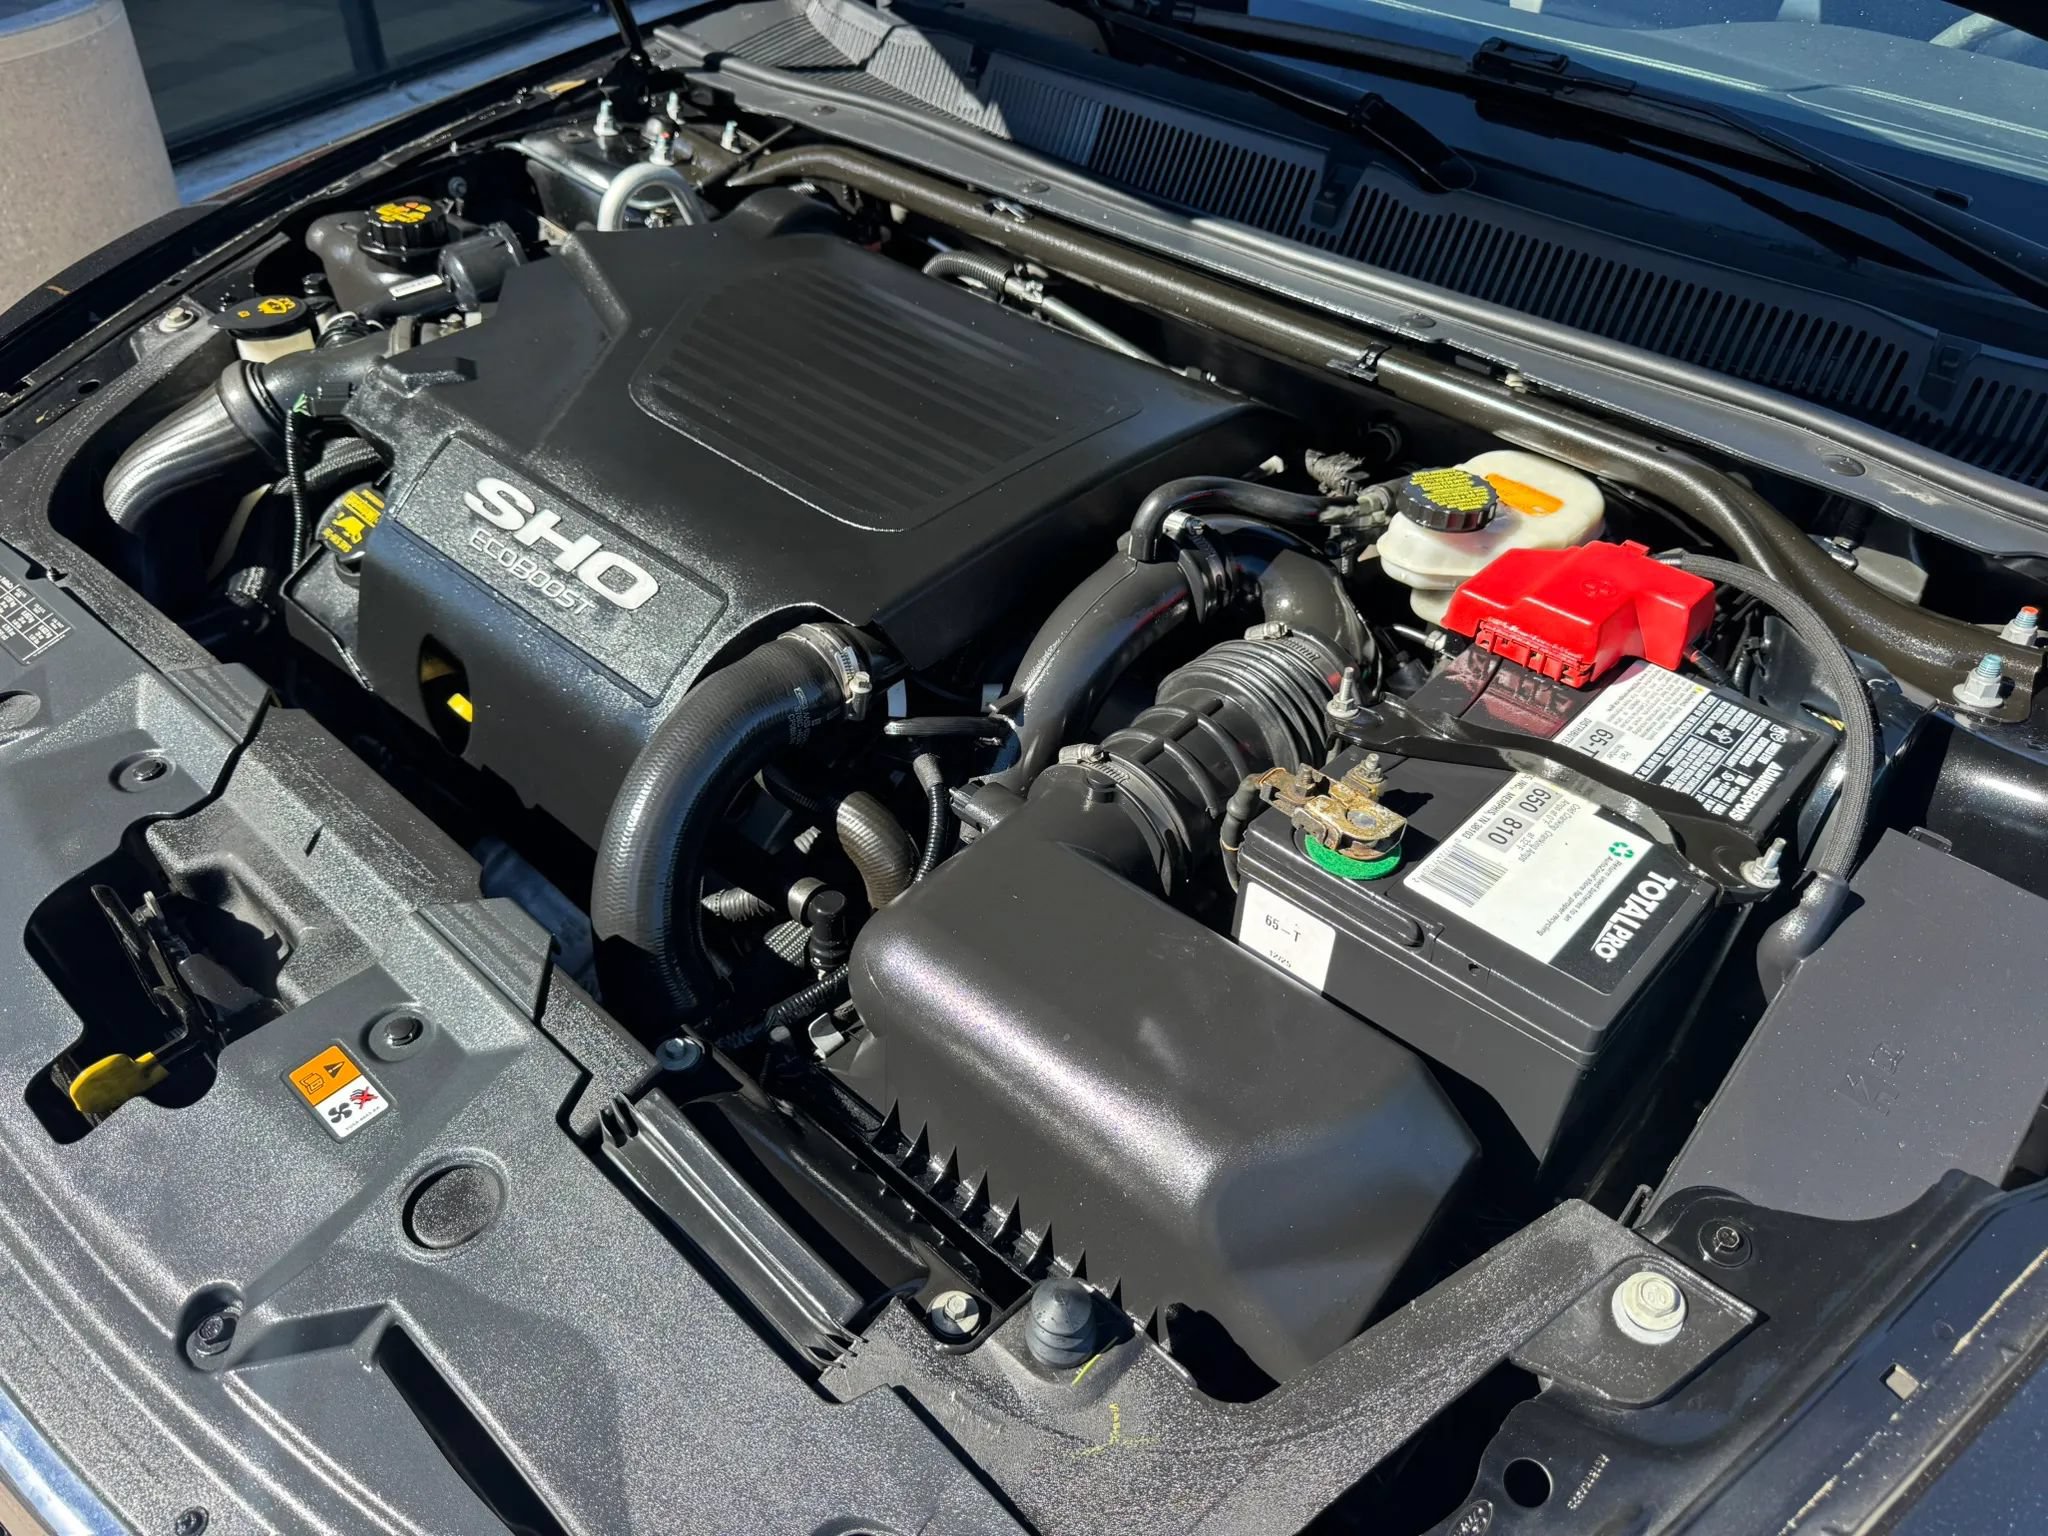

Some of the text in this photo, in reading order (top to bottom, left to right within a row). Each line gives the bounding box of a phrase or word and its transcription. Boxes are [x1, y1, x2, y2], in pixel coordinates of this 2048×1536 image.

[464, 477, 659, 610] SHO
[469, 528, 596, 615] ECOBOOST
[1574, 727, 1616, 757] 65-T
[1483, 790, 1515, 817] MEMPHIS,
[1517, 786, 1552, 814] 650
[1461, 822, 1482, 839] 38103
[1476, 814, 1490, 824] TN
[1485, 815, 1523, 846] 810
